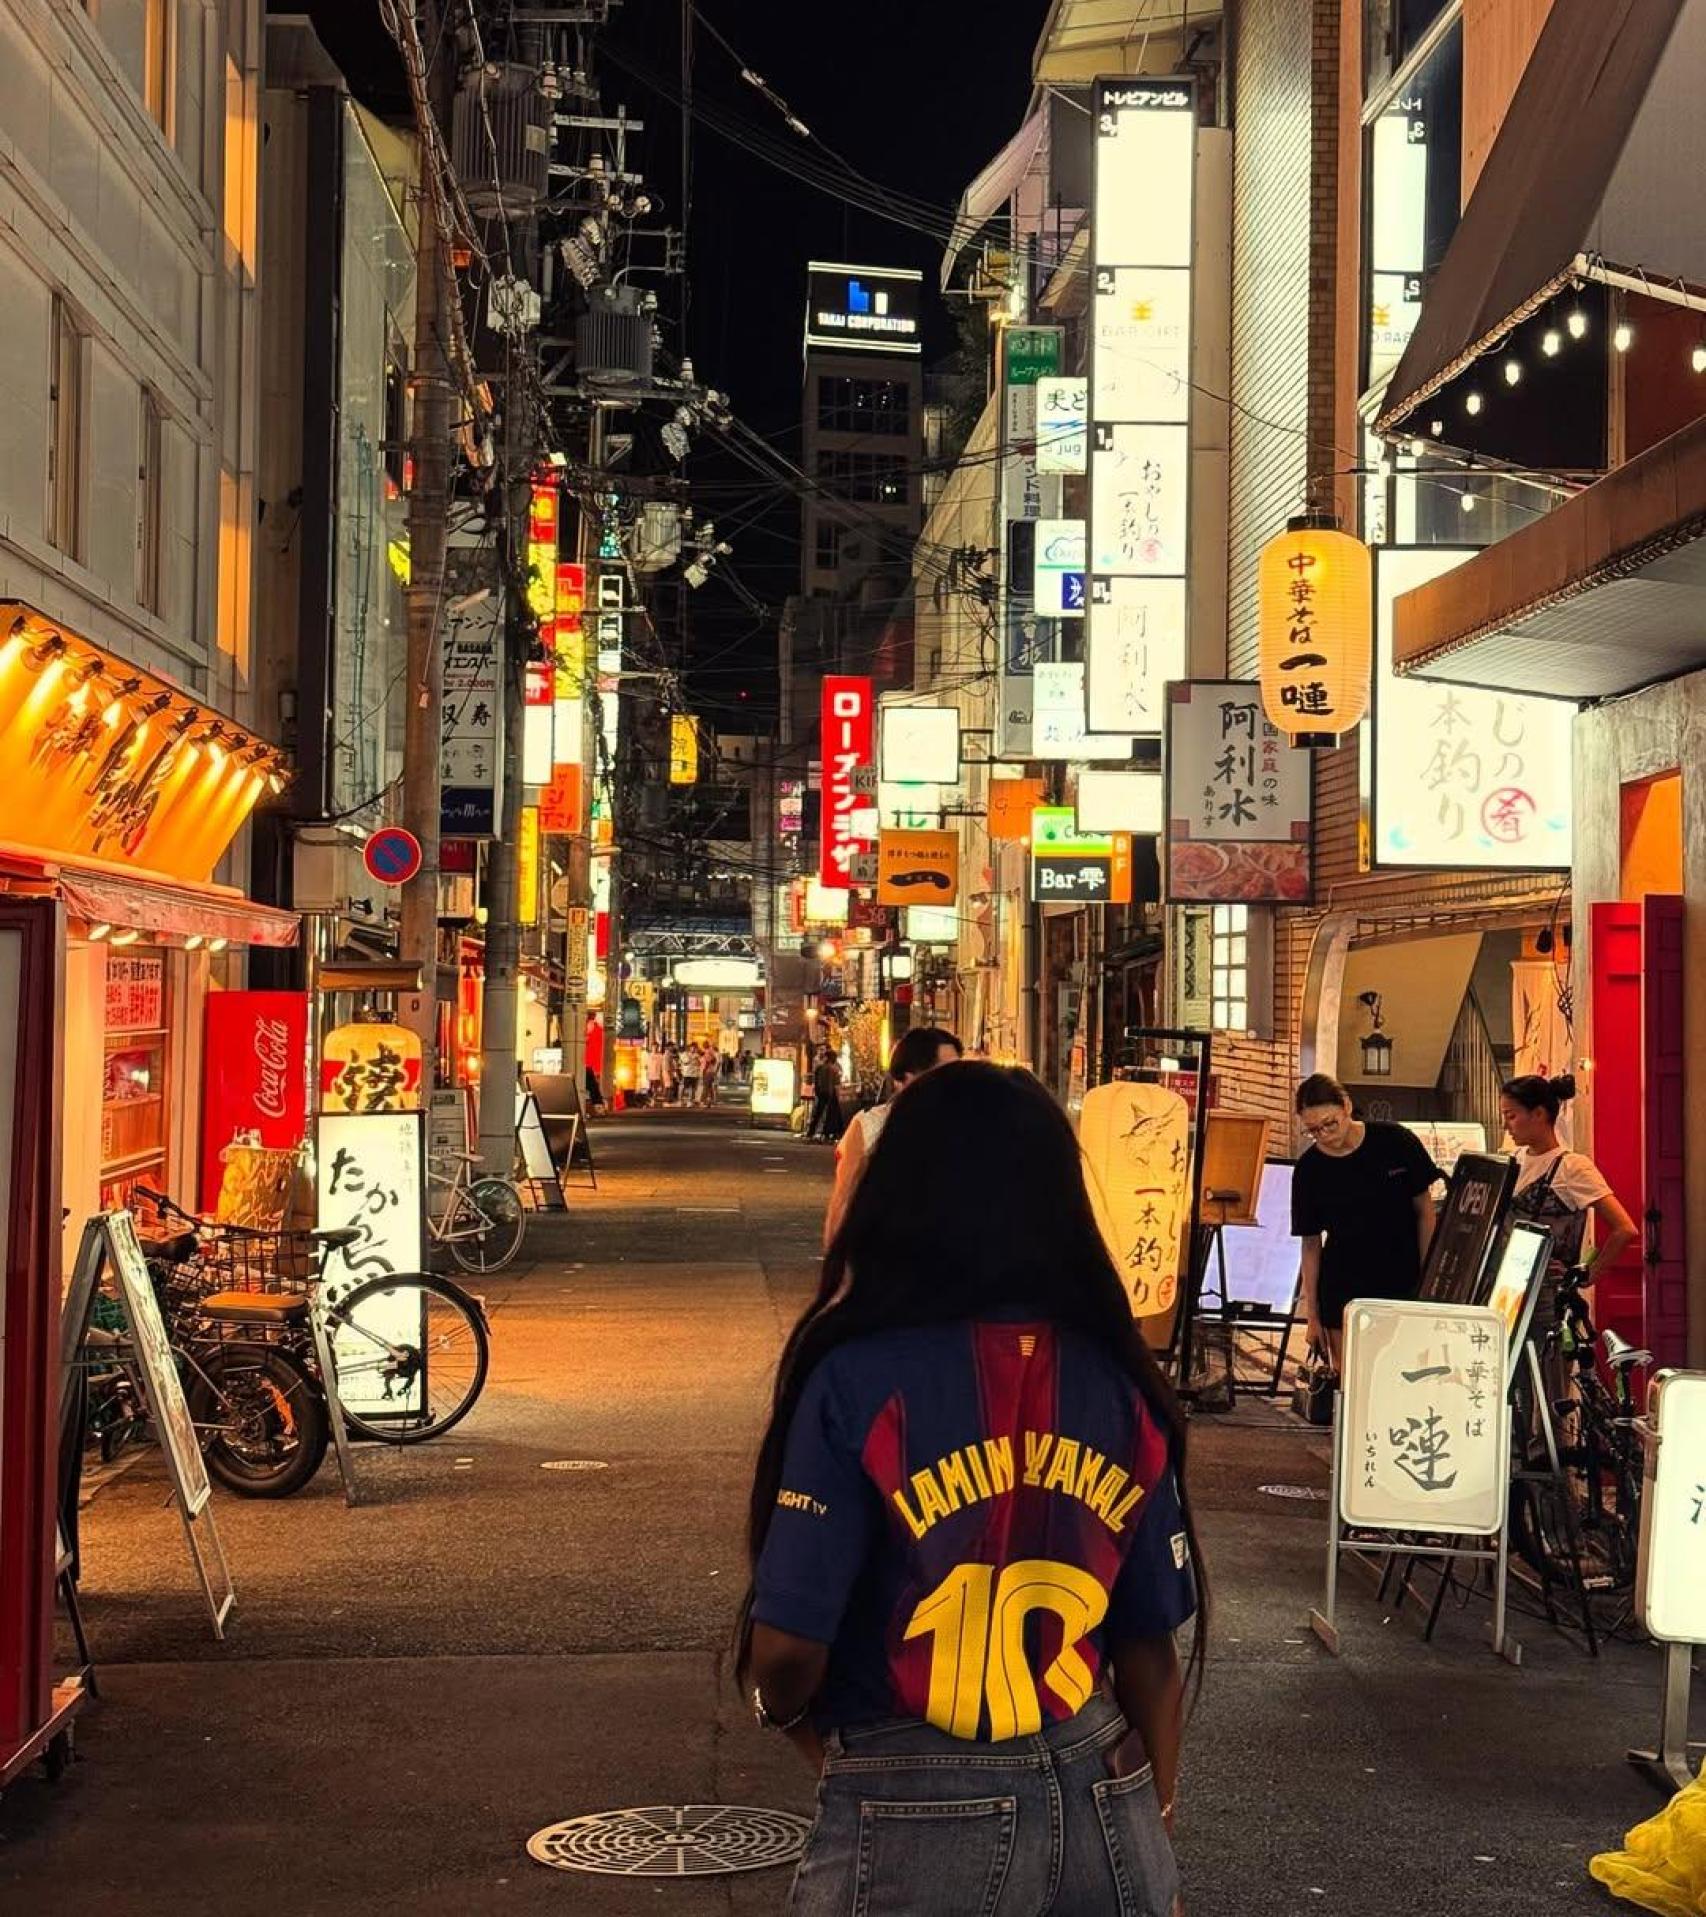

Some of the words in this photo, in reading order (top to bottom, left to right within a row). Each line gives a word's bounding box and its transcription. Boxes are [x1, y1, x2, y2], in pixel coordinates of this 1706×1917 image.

[1103, 90, 1189, 106] トレビアンビル
[1286, 552, 1318, 645] 中華そば
[1214, 701, 1260, 827] 阿利水
[253, 1015, 288, 1118] Coca-Cola
[1125, 1186, 1167, 1306] 一本釣り
[1465, 1327, 1492, 1438] 中華そば
[893, 1436, 1014, 1539] LAMIN
[1023, 1430, 1145, 1533] YAMAL
[1363, 1431, 1378, 1489] いちれん
[904, 1559, 1109, 1742] 10
